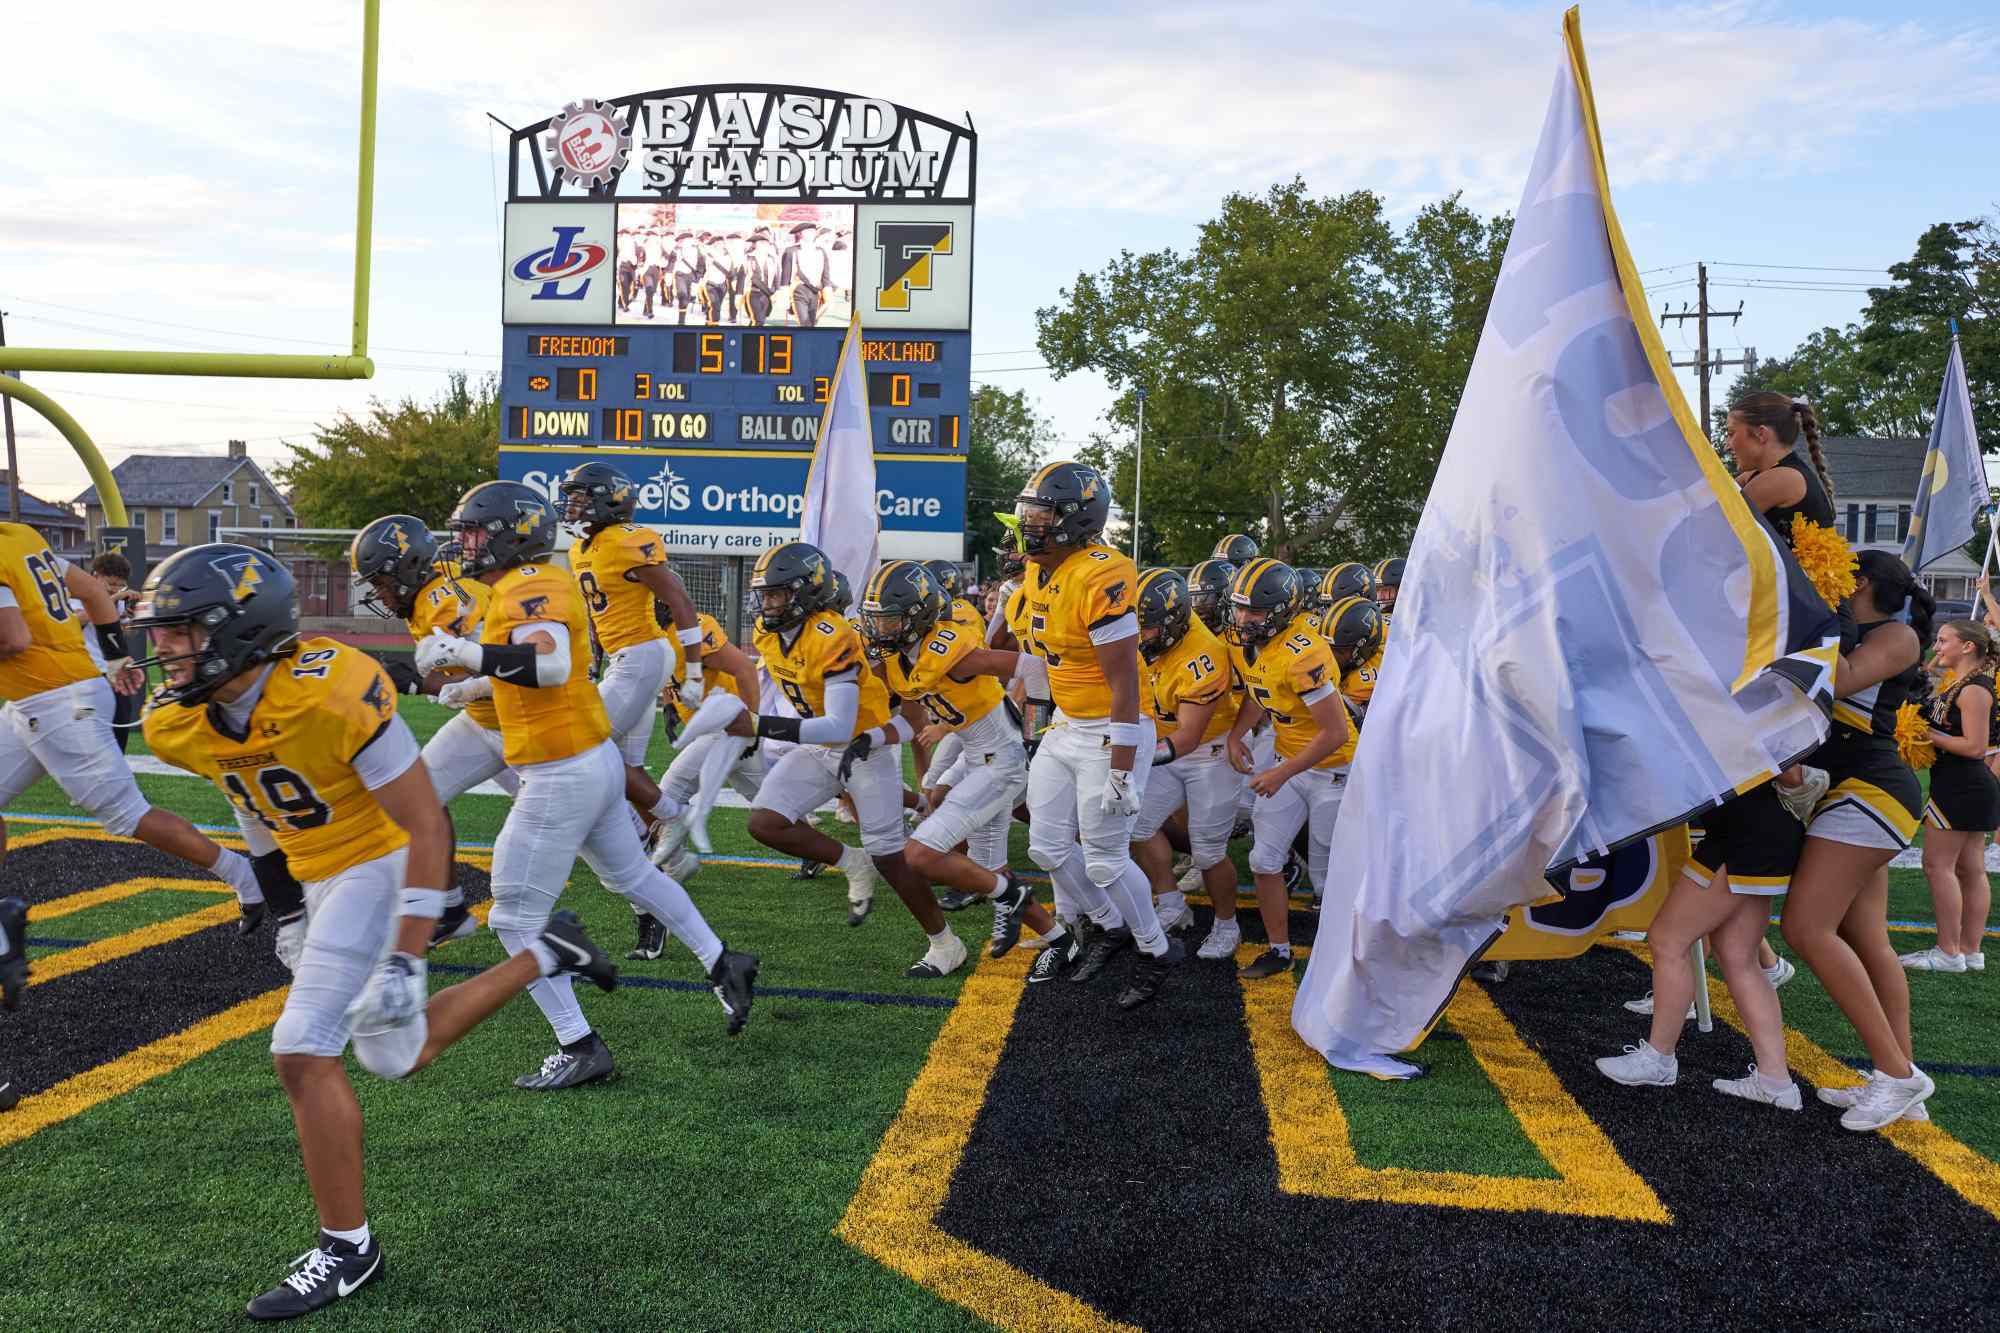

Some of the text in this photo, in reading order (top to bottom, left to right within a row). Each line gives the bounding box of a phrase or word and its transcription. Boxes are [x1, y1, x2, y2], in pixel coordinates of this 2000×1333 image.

[642, 97, 898, 148] BASD
[568, 135, 594, 170] BASD
[643, 150, 937, 190] STADIUM
[875, 221, 953, 311] F
[538, 335, 616, 357] FREEDOM
[701, 333, 792, 374] 5:13
[861, 341, 935, 362] ARKLAND
[577, 367, 598, 400] 0
[635, 373, 685, 400] 3 TOL
[777, 385, 805, 401] TOL
[891, 374, 911, 407] 0
[522, 407, 590, 439] 1 DOWN
[615, 408, 707, 441] 10 TO GO
[741, 415, 819, 442] BALL ON
[891, 416, 959, 449] QTR 1
[702, 484, 805, 520] Orthop
[876, 489, 941, 517] Care
[725, 534, 762, 547] care
[768, 532, 784, 548] in
[927, 627, 959, 657] 80
[1283, 632, 1313, 656] 15
[292, 648, 338, 679] 19
[1185, 652, 1216, 682] 72
[221, 765, 334, 832] 19
